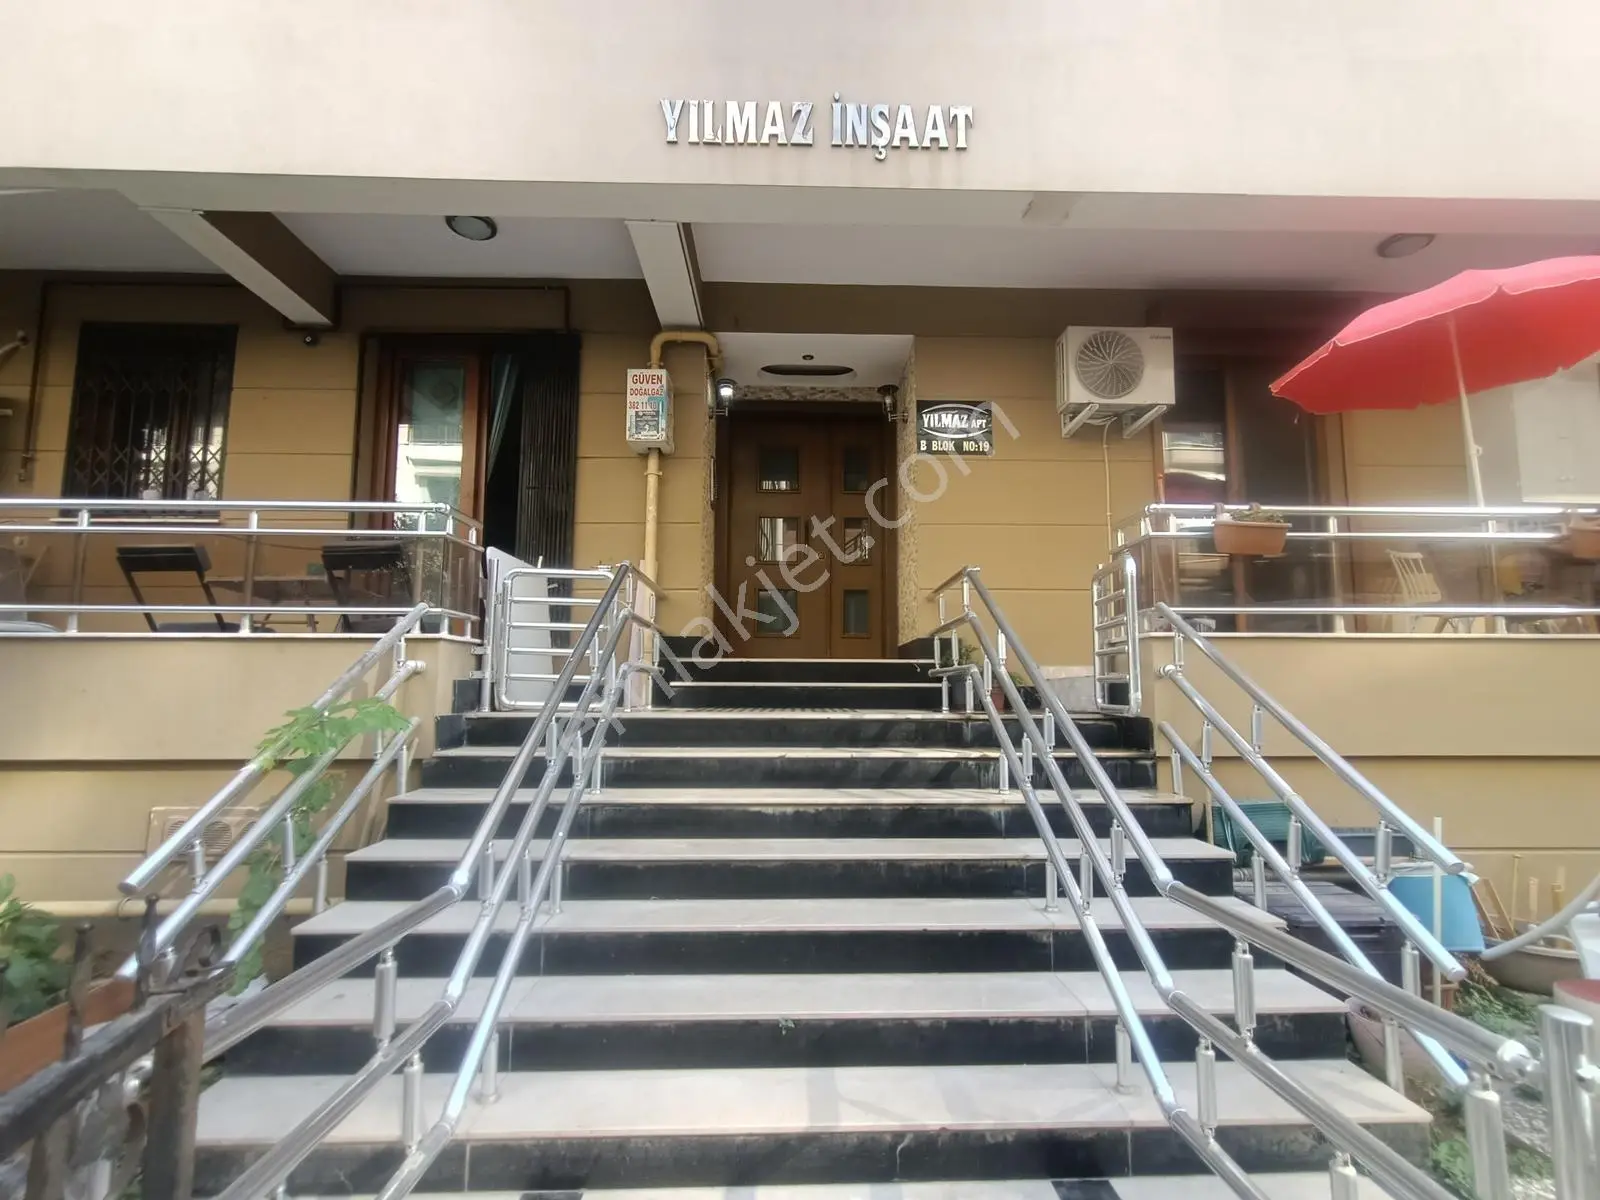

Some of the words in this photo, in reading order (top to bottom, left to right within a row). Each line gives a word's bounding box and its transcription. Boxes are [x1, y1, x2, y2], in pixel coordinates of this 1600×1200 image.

[659, 98, 814, 146] YILMAZ
[831, 91, 973, 161] İNŞAAT
[631, 372, 663, 385] GÜVEN
[629, 387, 664, 396] DOĞALGAZ
[922, 413, 969, 429] YILMAZ
[971, 419, 987, 429] APT
[920, 440, 927, 451] B
[931, 440, 956, 452] BLOK
[963, 441, 990, 452] NO:19
